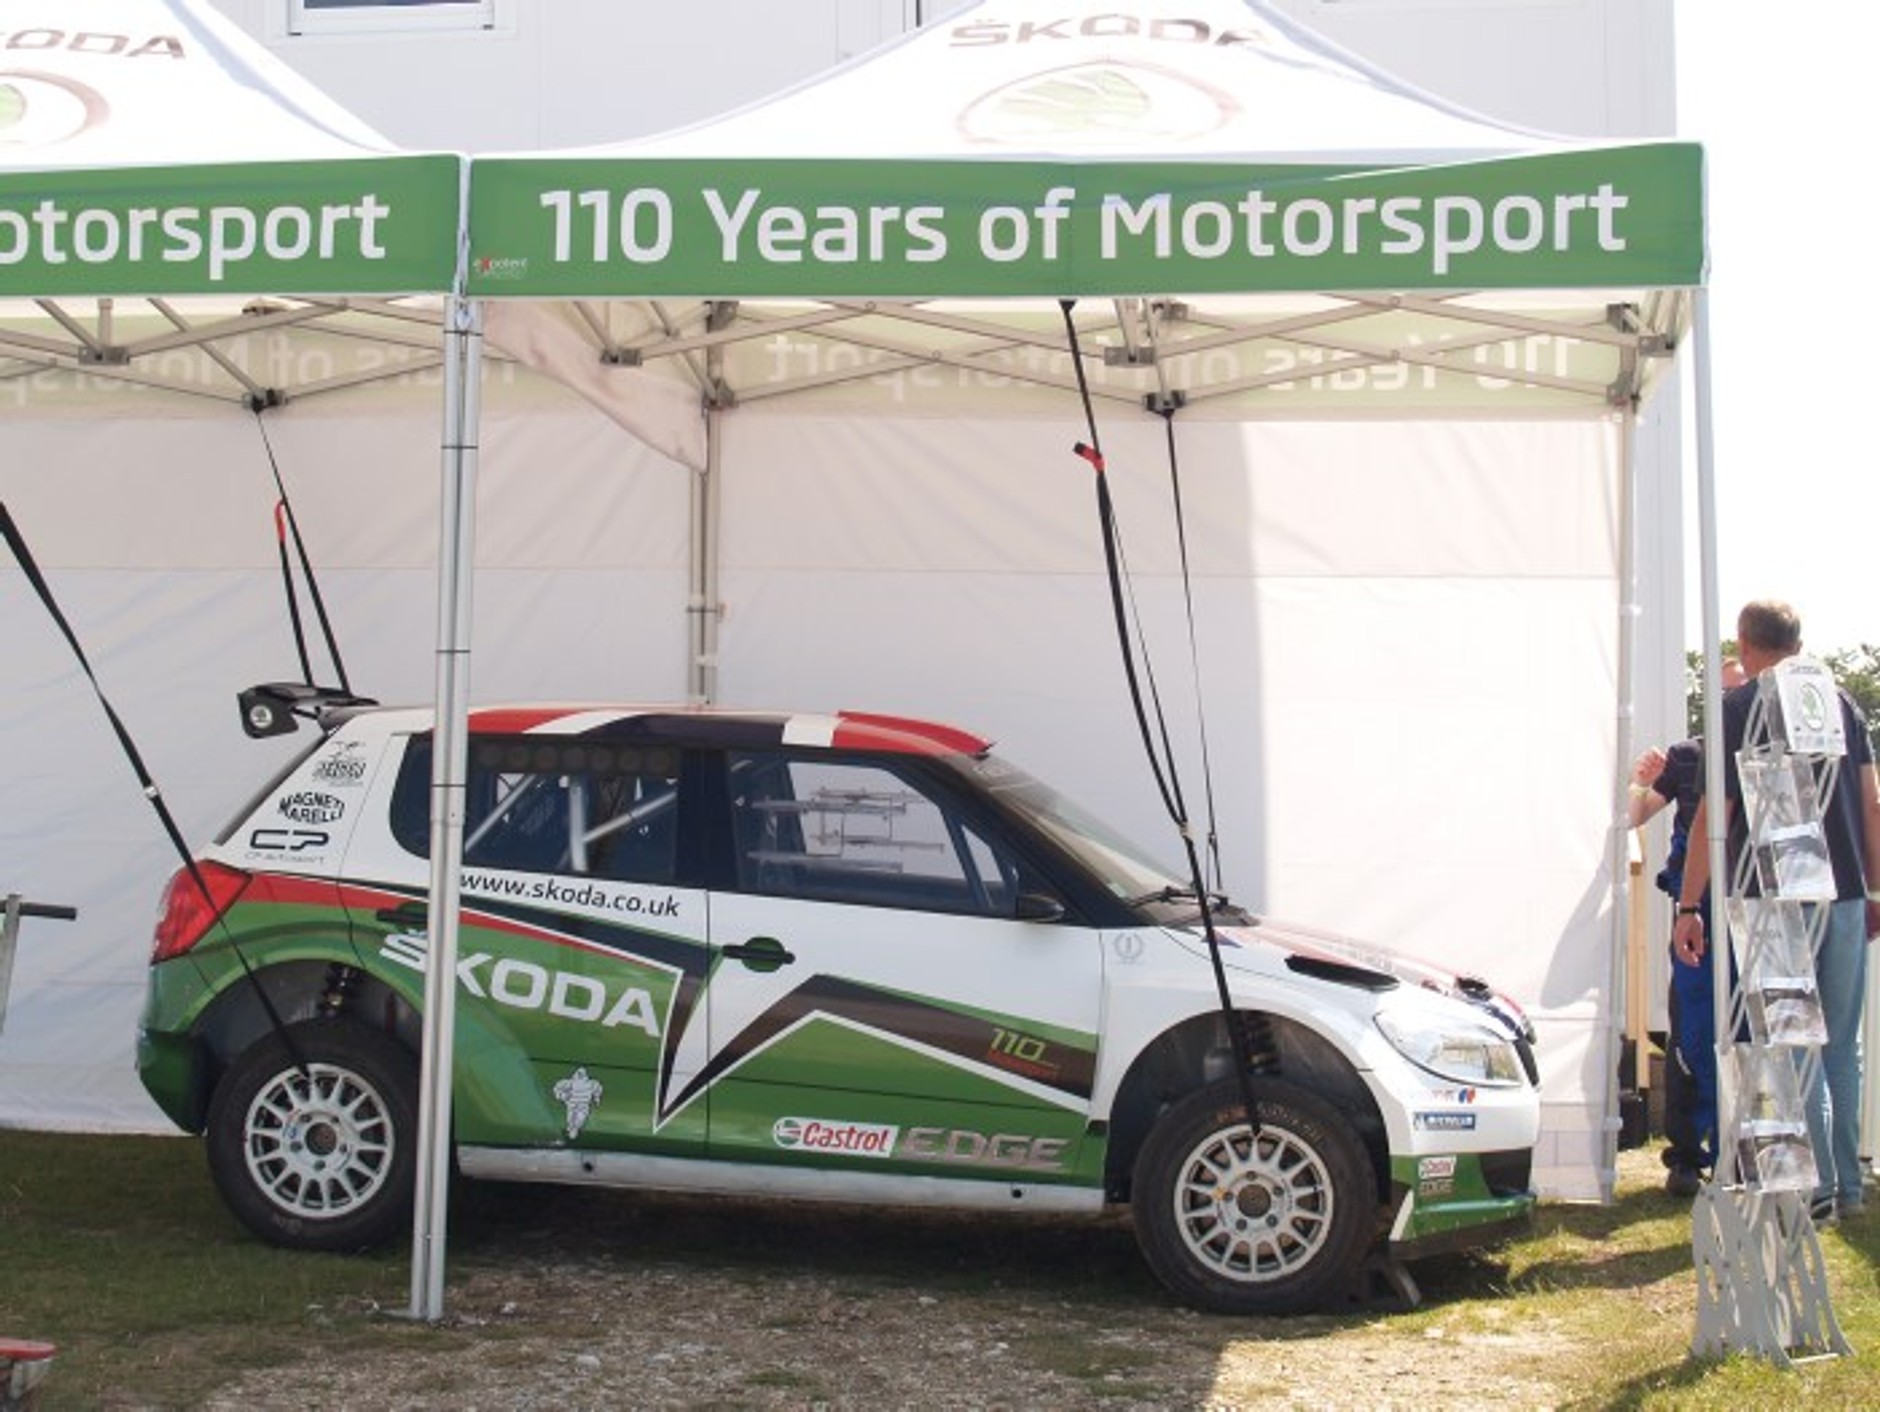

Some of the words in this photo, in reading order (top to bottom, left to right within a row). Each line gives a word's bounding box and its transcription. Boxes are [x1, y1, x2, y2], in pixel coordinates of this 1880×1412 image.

[0, 28, 185, 60] ODA
[540, 187, 673, 263] 110
[703, 188, 947, 263] Years
[979, 186, 1075, 262] of
[1100, 184, 1628, 275] Motorsport
[460, 872, 681, 917] www.skoda.co.uk
[991, 1027, 1046, 1061] 110
[803, 1121, 891, 1152] Castrol
[899, 1126, 1072, 1168] EDGE
